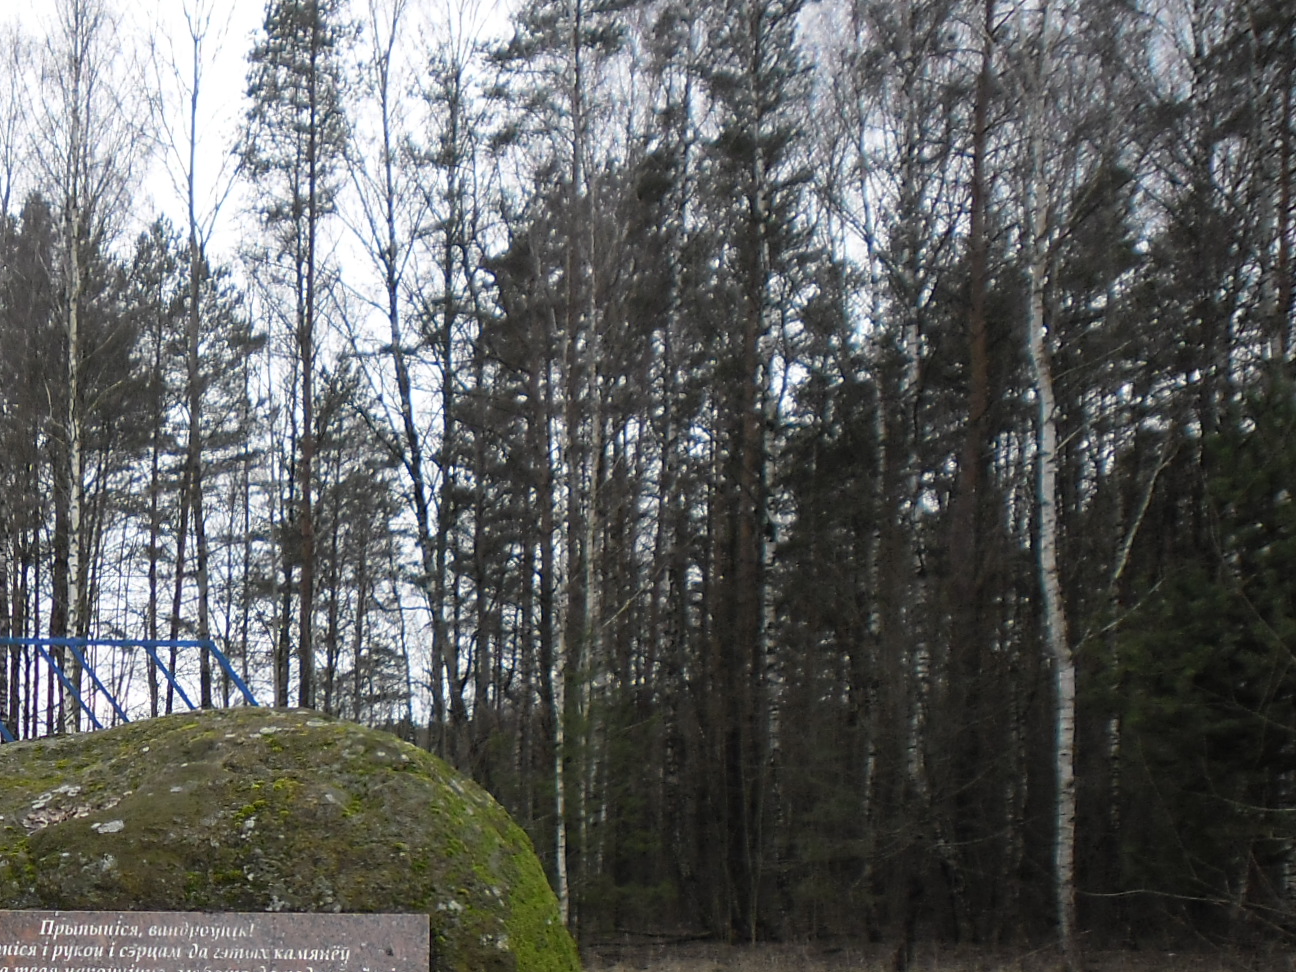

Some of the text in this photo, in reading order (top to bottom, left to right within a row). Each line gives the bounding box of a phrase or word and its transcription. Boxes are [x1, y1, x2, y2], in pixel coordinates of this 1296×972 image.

[39, 919, 143, 939] Прыпыніся,
[42, 941, 49, 957] і
[109, 942, 116, 958] і
[188, 944, 208, 959] да
